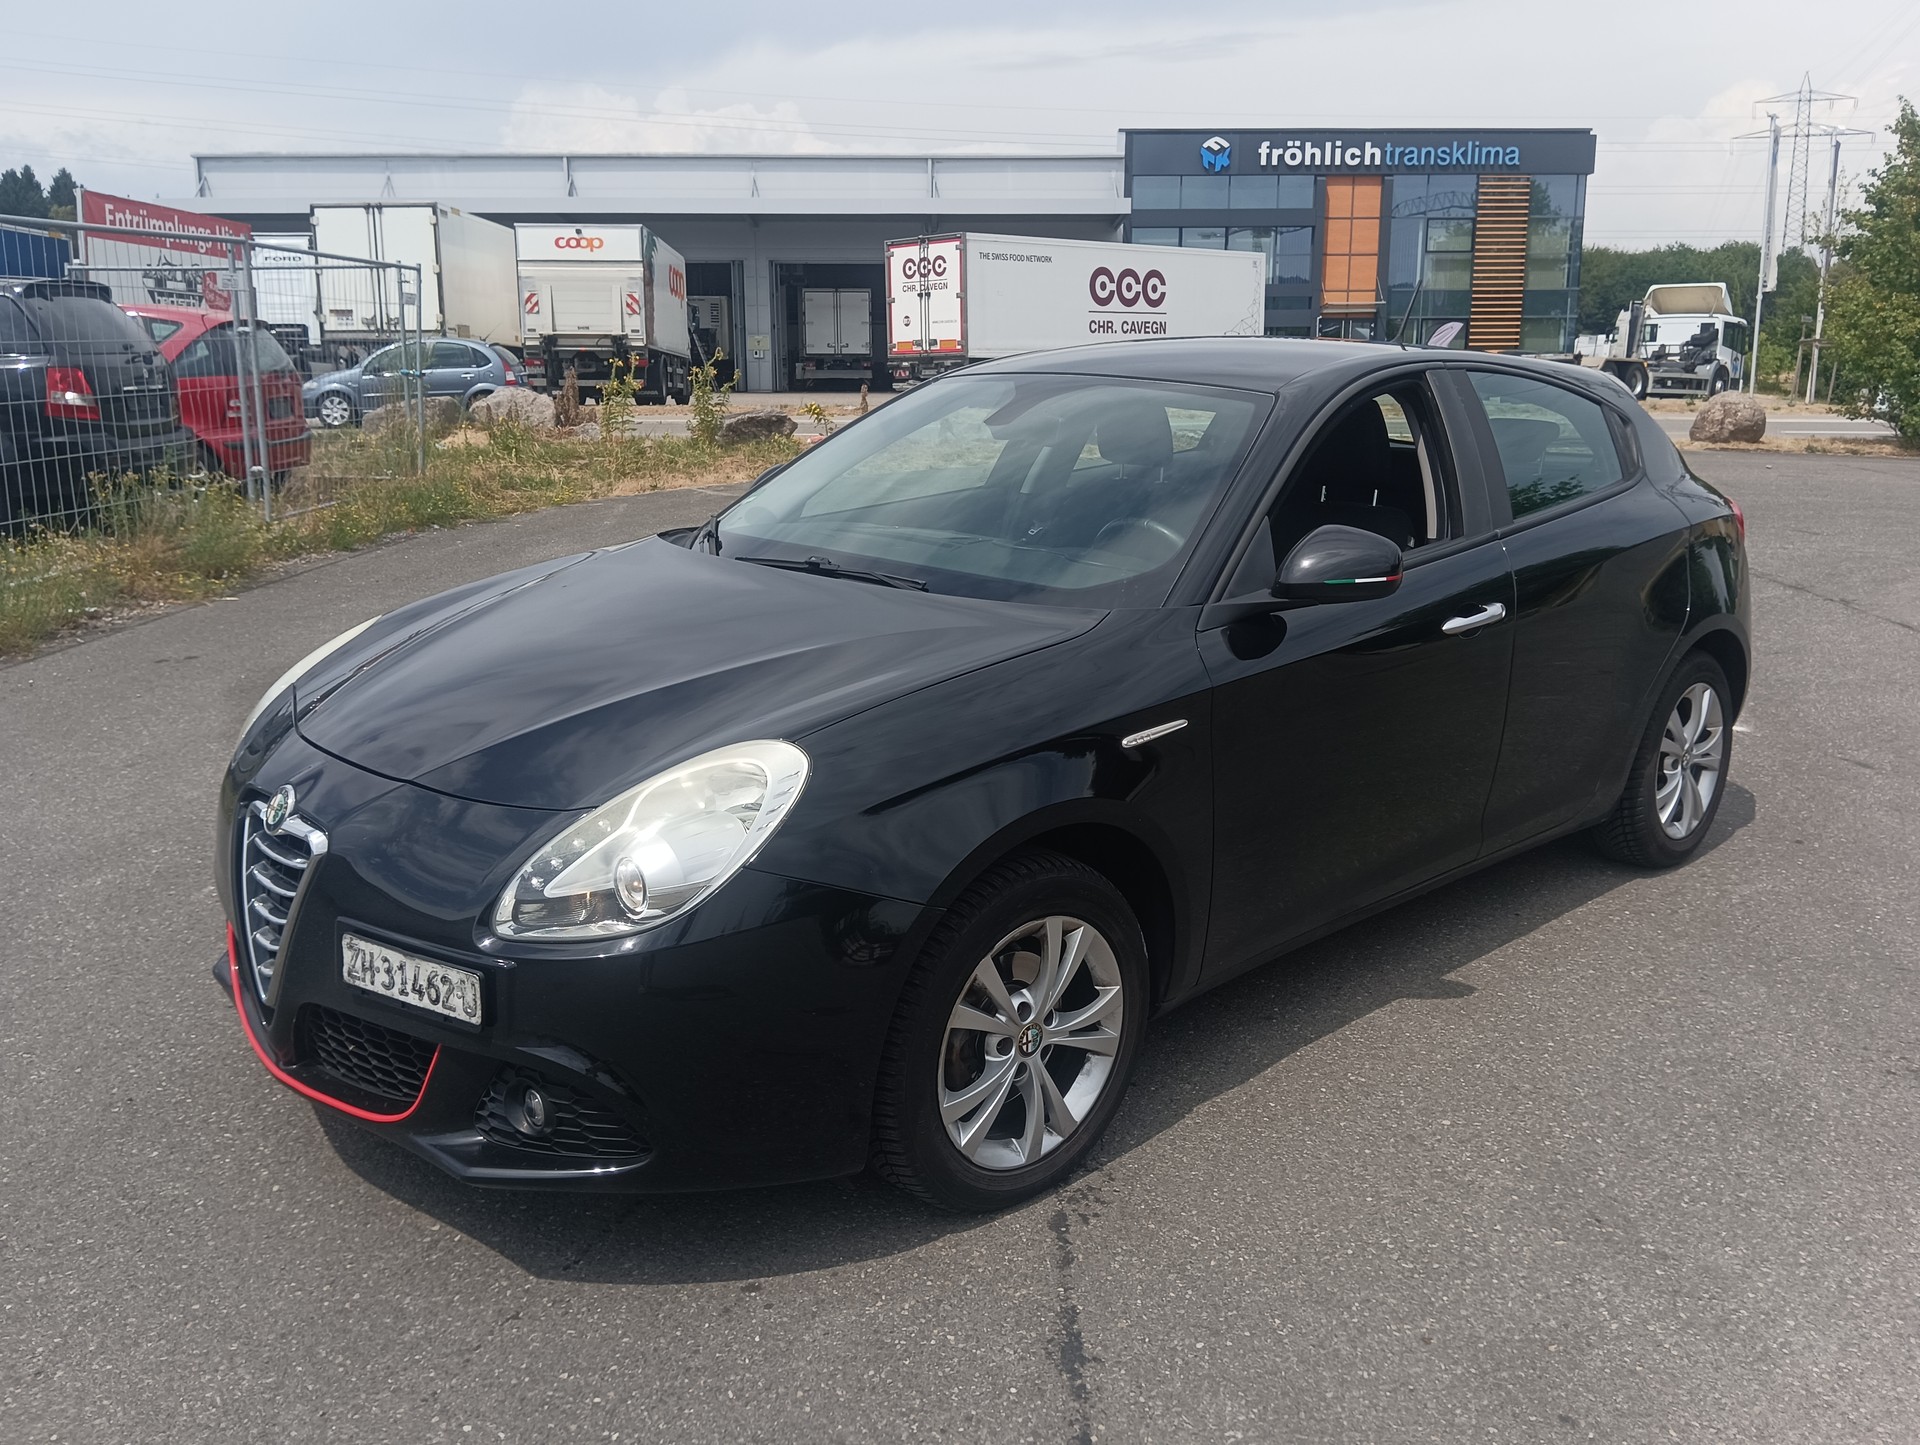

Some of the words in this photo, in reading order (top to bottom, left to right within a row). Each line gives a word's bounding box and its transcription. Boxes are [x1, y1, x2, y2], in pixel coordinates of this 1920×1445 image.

[554, 236, 604, 252] coop
[979, 251, 990, 260] THE
[991, 252, 1009, 261] SWISS
[1009, 253, 1025, 262] FOOD
[1026, 254, 1053, 263] NETWORK
[902, 254, 948, 280] CCC
[902, 284, 918, 293] CHR.
[1089, 266, 1167, 308] CCC
[1089, 319, 1117, 334] CHR.
[1121, 320, 1167, 335] CAVEGN
